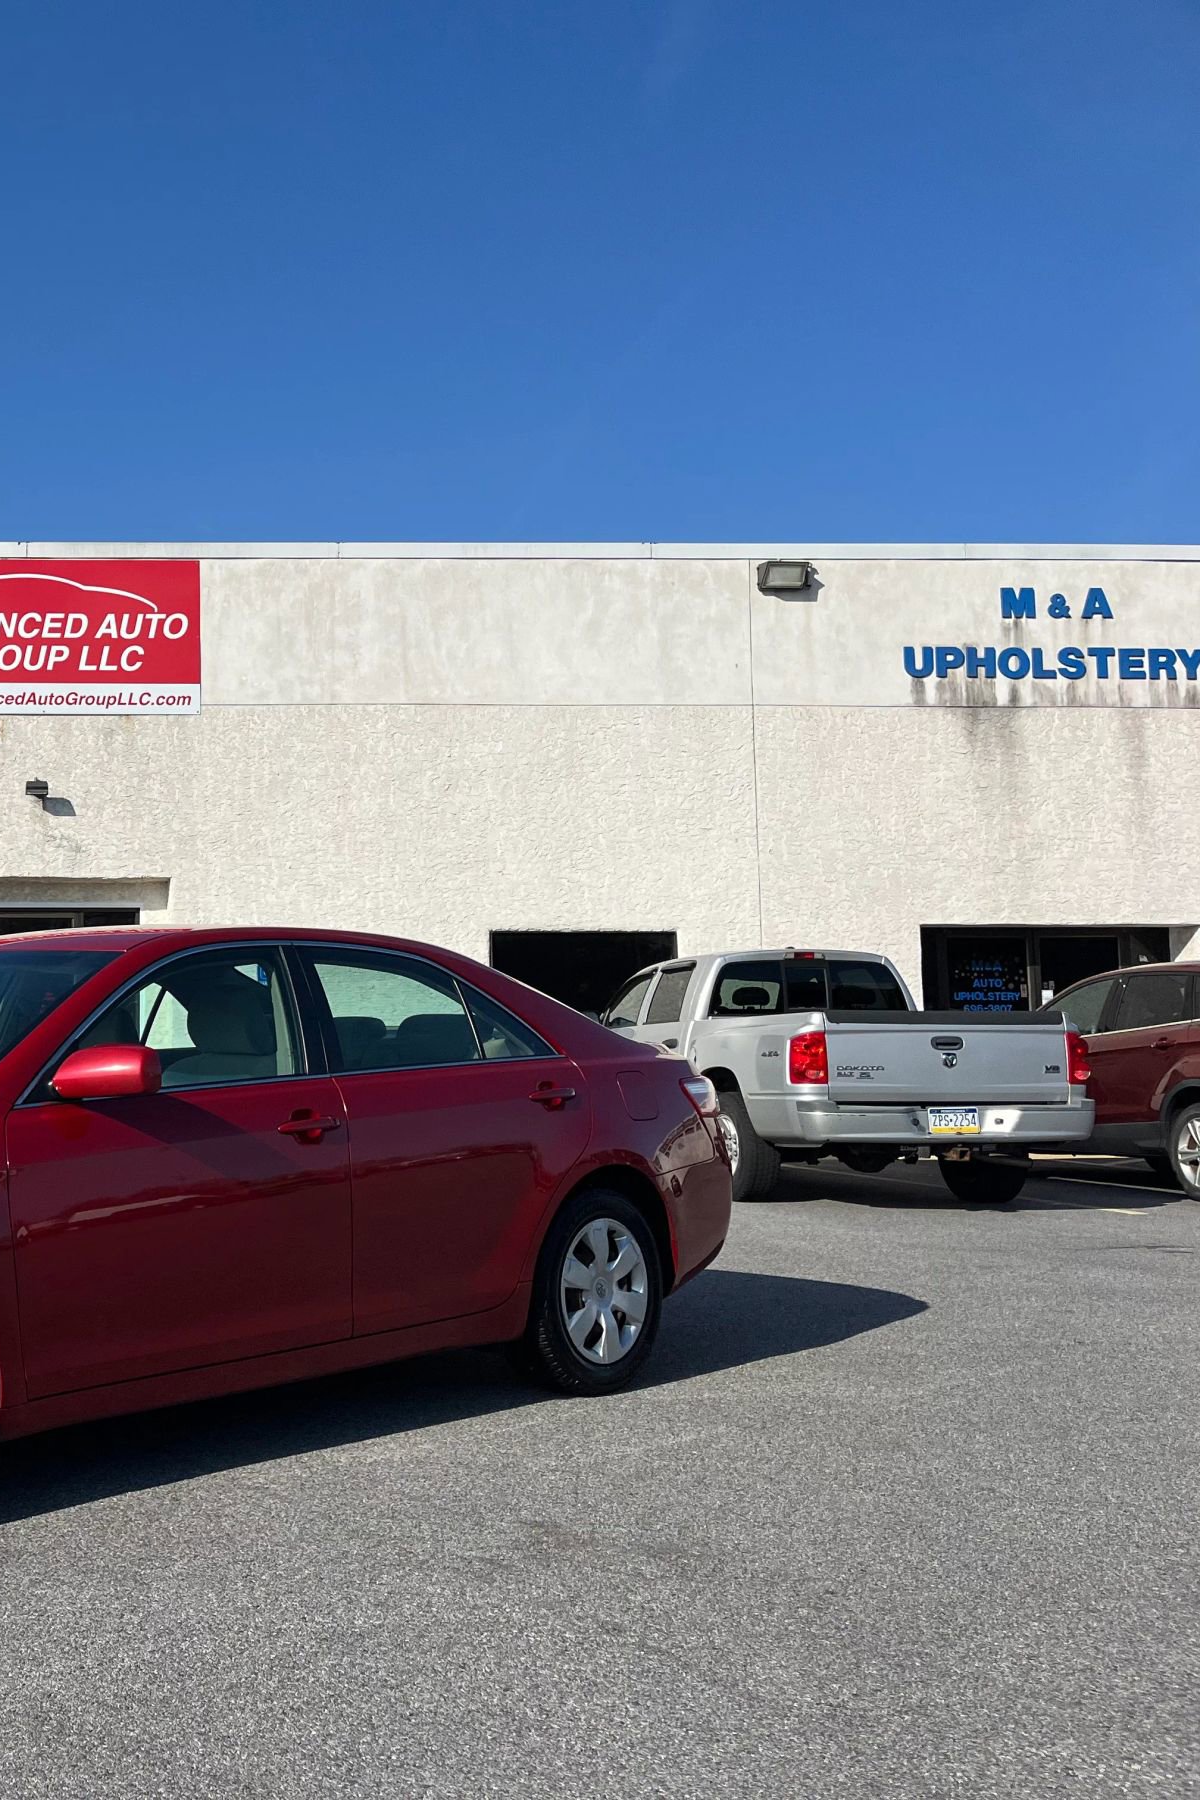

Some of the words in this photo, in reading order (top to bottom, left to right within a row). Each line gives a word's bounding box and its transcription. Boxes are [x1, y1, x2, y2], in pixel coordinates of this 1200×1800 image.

[1000, 587, 1036, 619] M
[1047, 593, 1071, 619] &
[1081, 587, 1113, 619] A
[95, 613, 189, 639] AUTO
[78, 645, 144, 672] LLC
[903, 646, 1200, 680] UPHOLSTERY
[954, 992, 1020, 1001] UPHOLSTERY
[973, 979, 1003, 988] AUTO
